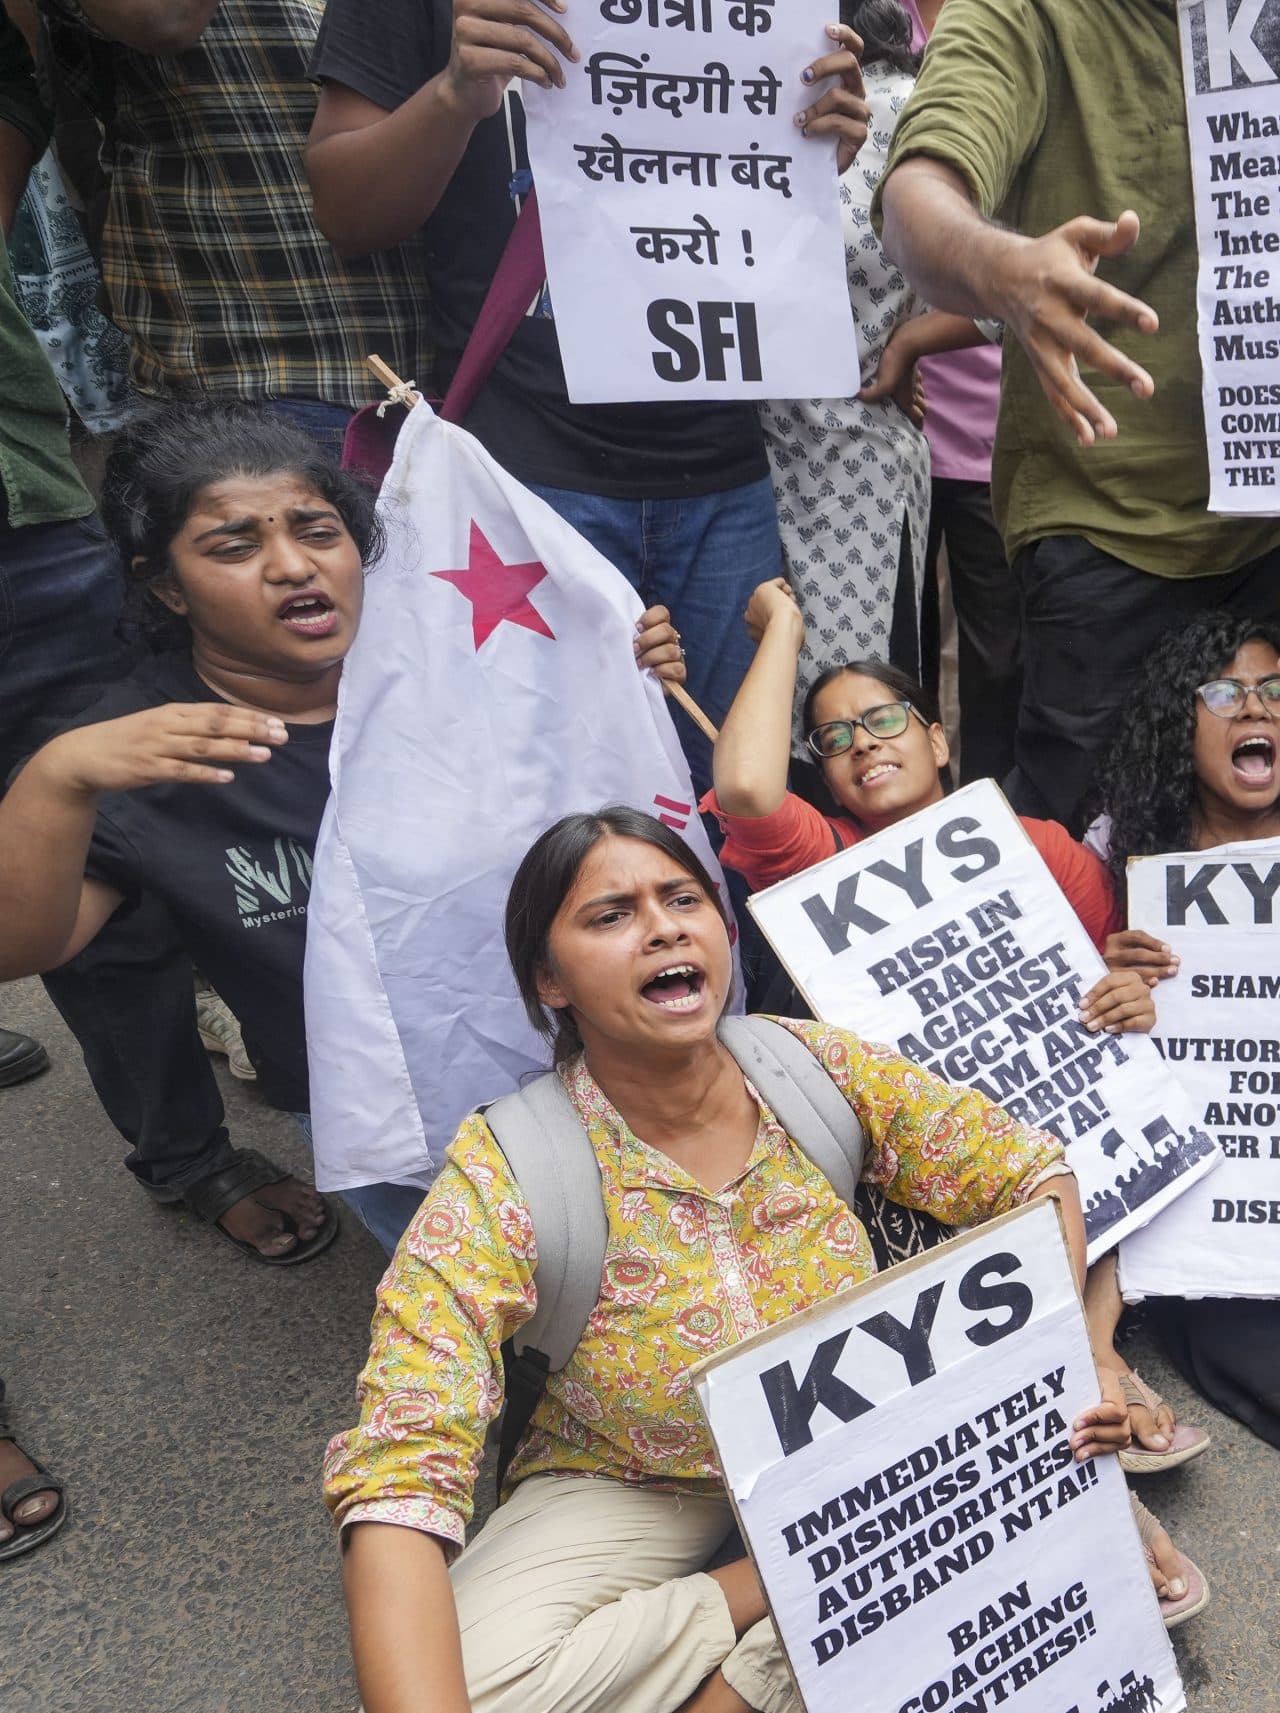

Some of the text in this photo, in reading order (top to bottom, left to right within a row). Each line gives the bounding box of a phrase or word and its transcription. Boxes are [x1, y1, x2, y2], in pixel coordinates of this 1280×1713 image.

[584, 52, 782, 118] ज़िंदगी से
[573, 133, 792, 198] खेलना बंद
[1211, 190, 1270, 220] The
[629, 213, 720, 265] करो
[1213, 265, 1270, 290] The
[646, 298, 763, 383] SFI
[1225, 467, 1275, 487] THE
[800, 816, 1001, 956] KYS
[866, 889, 1023, 996] RISE IN
[906, 930, 1025, 1017] RAGE
[897, 942, 1071, 1065] AGAINST
[759, 1252, 1033, 1457] KYS
[781, 1366, 1066, 1556] IMMEDIATELY
[807, 1408, 1067, 1584] DISMISS NTA
[810, 1459, 1099, 1666] DISBAND NTA!!
[816, 1439, 1074, 1624] AUTHORITIES
[948, 1580, 1032, 1657] BAN
